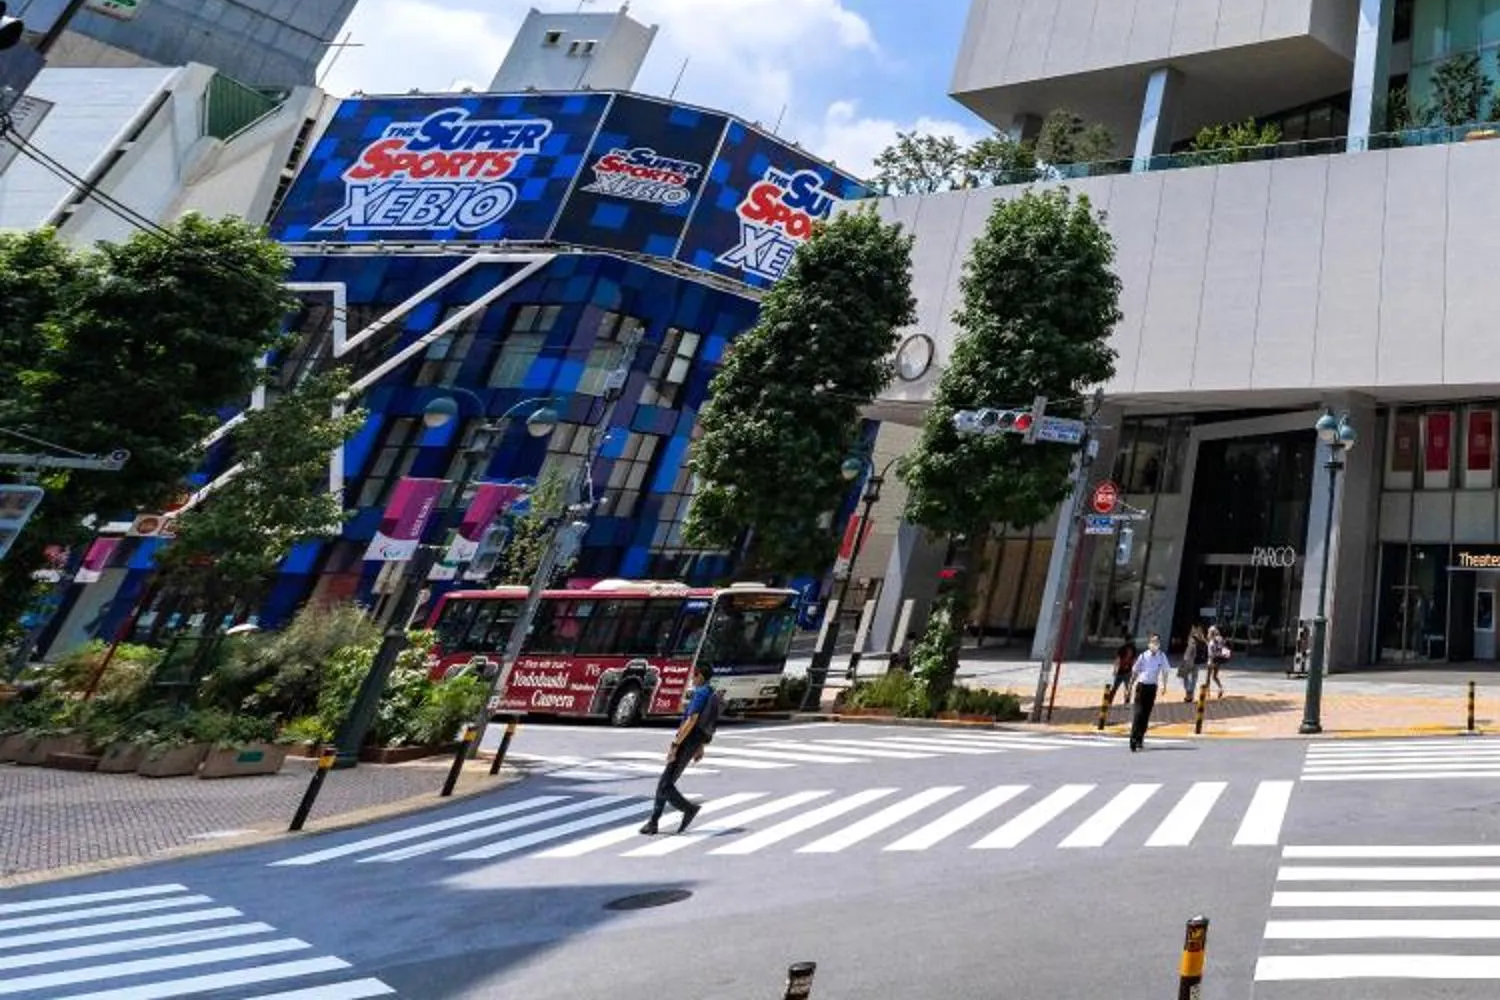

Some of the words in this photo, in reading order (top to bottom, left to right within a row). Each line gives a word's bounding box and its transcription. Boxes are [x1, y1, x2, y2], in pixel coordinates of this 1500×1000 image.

[387, 124, 419, 138] THE
[347, 139, 520, 180] SPORTS
[314, 182, 518, 231] XEBIO
[741, 183, 814, 241] SPO
[784, 172, 834, 217] SU
[716, 224, 799, 281] XE
[1251, 546, 1295, 568] PARCO
[531, 689, 575, 708] Camera
